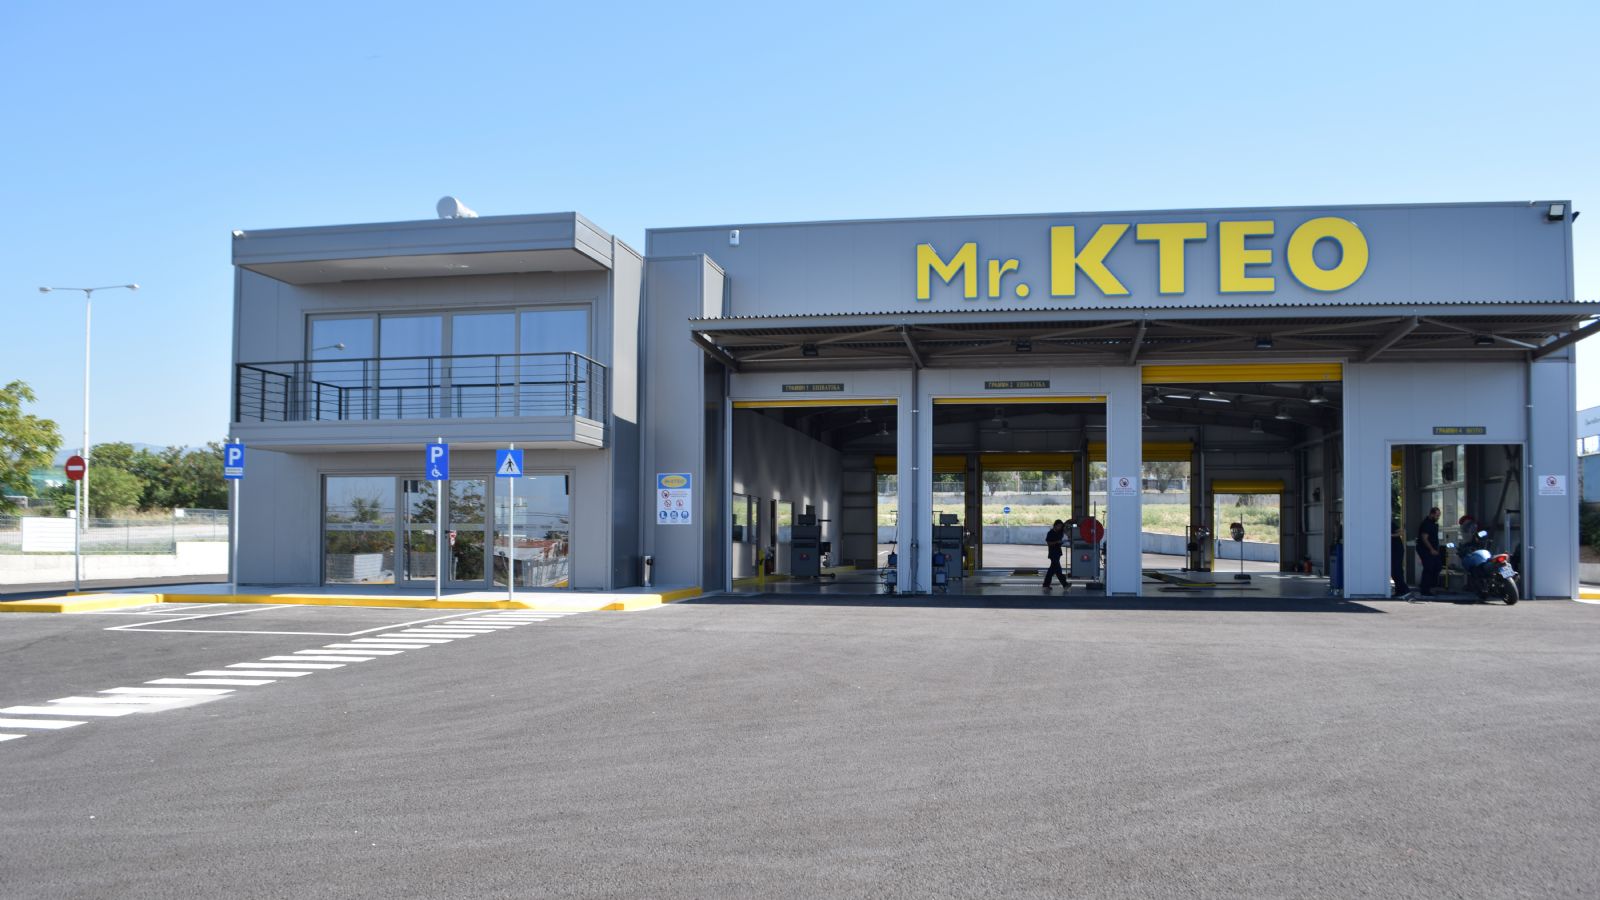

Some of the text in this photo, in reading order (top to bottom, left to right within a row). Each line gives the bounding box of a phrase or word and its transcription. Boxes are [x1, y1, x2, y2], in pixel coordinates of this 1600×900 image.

[915, 216, 1369, 300] Mr. KTEO
[229, 447, 242, 466] P
[431, 446, 444, 464] P
